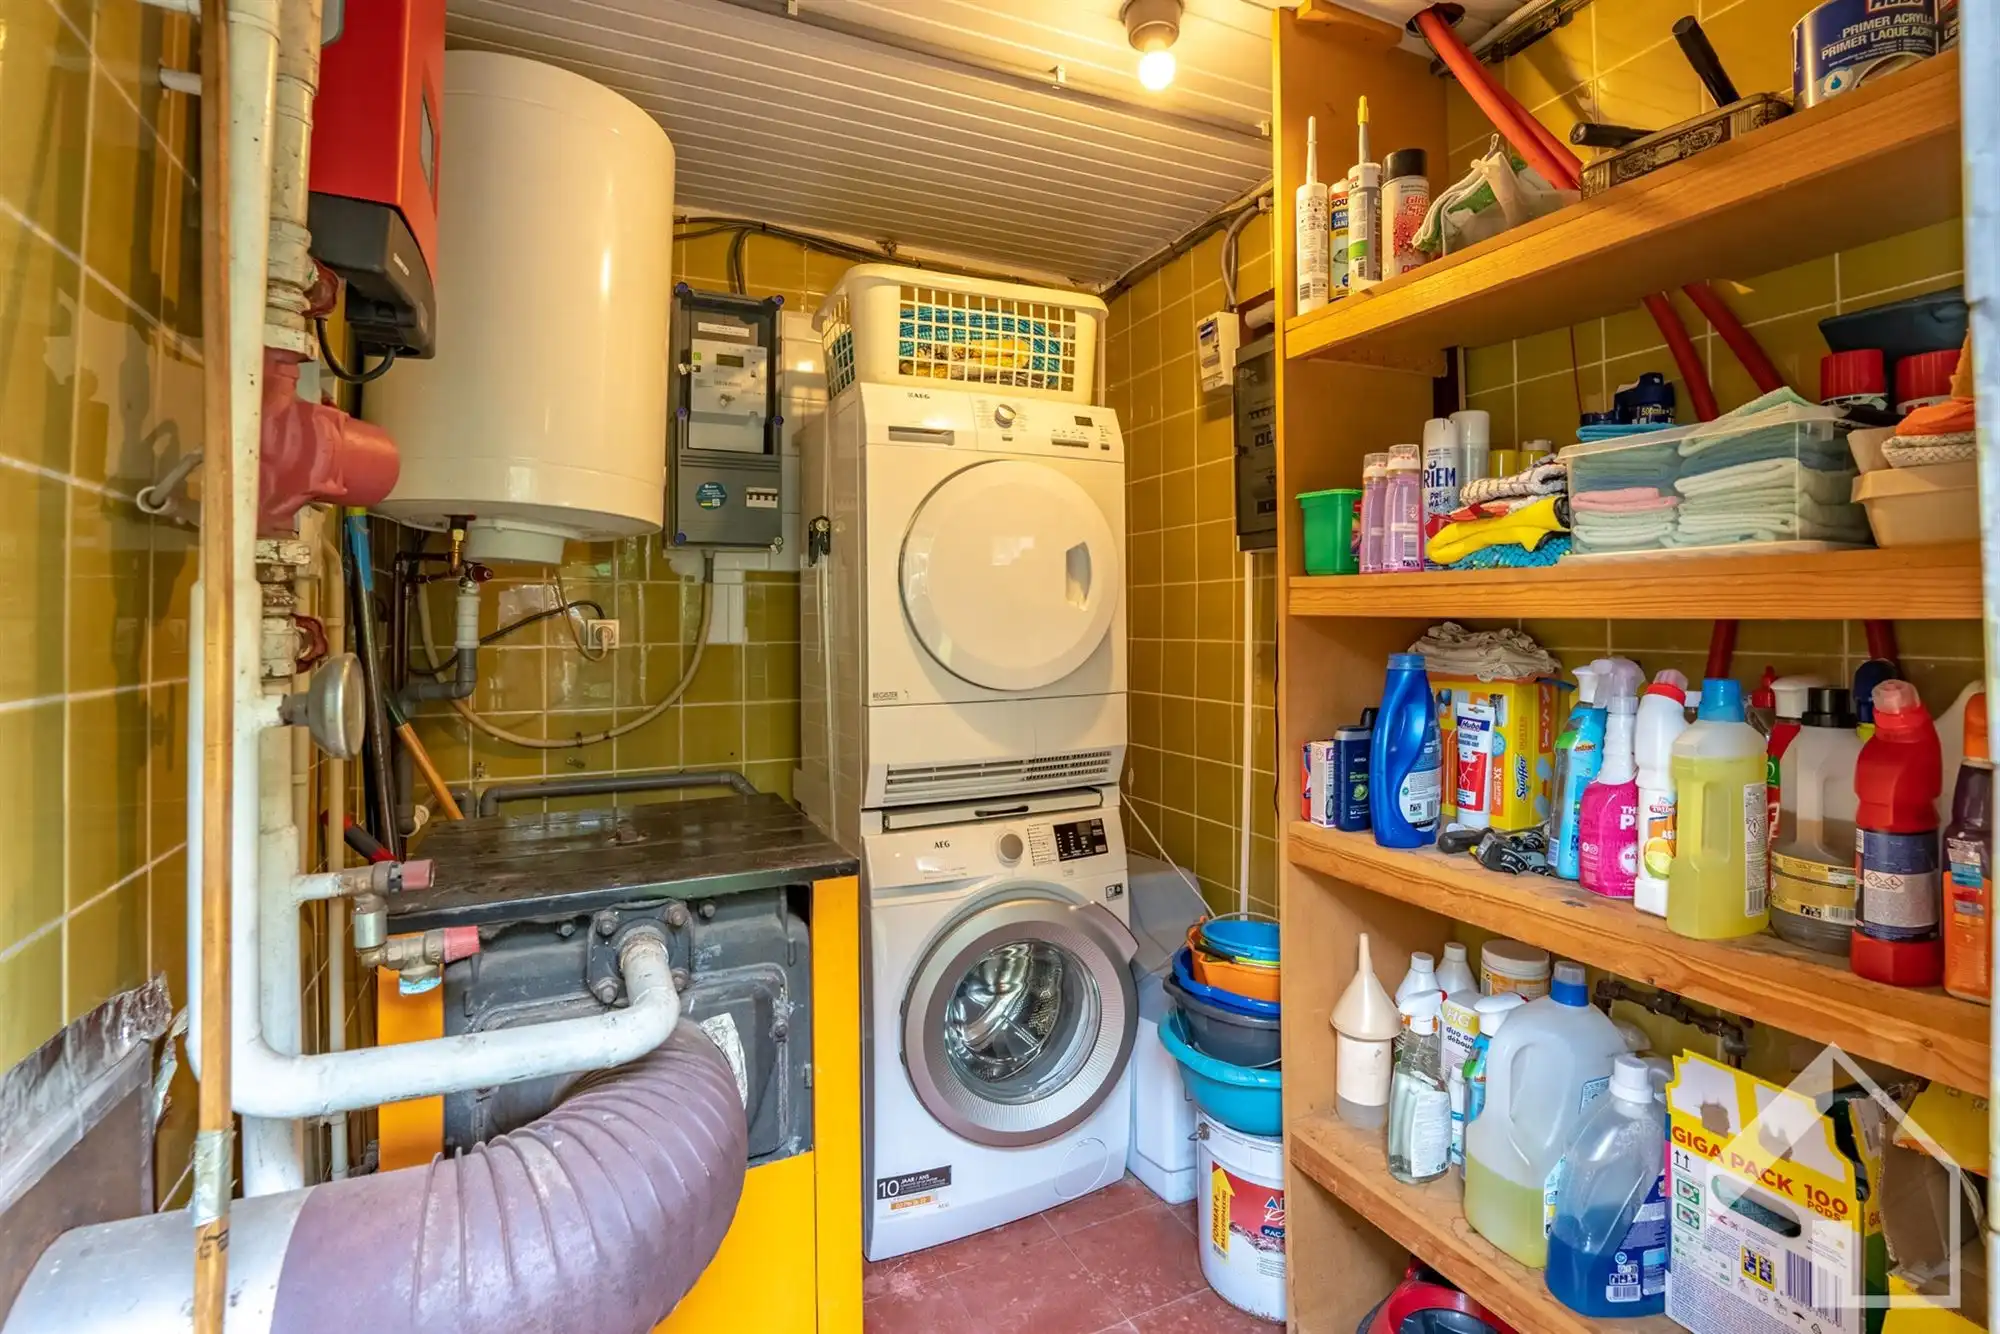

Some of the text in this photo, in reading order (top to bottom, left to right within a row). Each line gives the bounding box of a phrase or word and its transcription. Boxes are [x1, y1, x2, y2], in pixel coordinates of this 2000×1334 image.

[1842, 16, 1890, 38] PRIMER
[1822, 34, 1867, 60] PRIMER
[1870, 26, 1909, 42] LAQUE
[1331, 198, 1348, 209] SOU
[1516, 756, 1529, 801] Swiffer
[1620, 805, 1636, 815] TH
[1620, 813, 1636, 830] P
[934, 840, 951, 850] AEG
[1446, 1007, 1471, 1029] HG
[1446, 1026, 1475, 1044] duo on
[1671, 1125, 1849, 1216] GIGA PACK 100
[879, 1180, 900, 1198] 10
